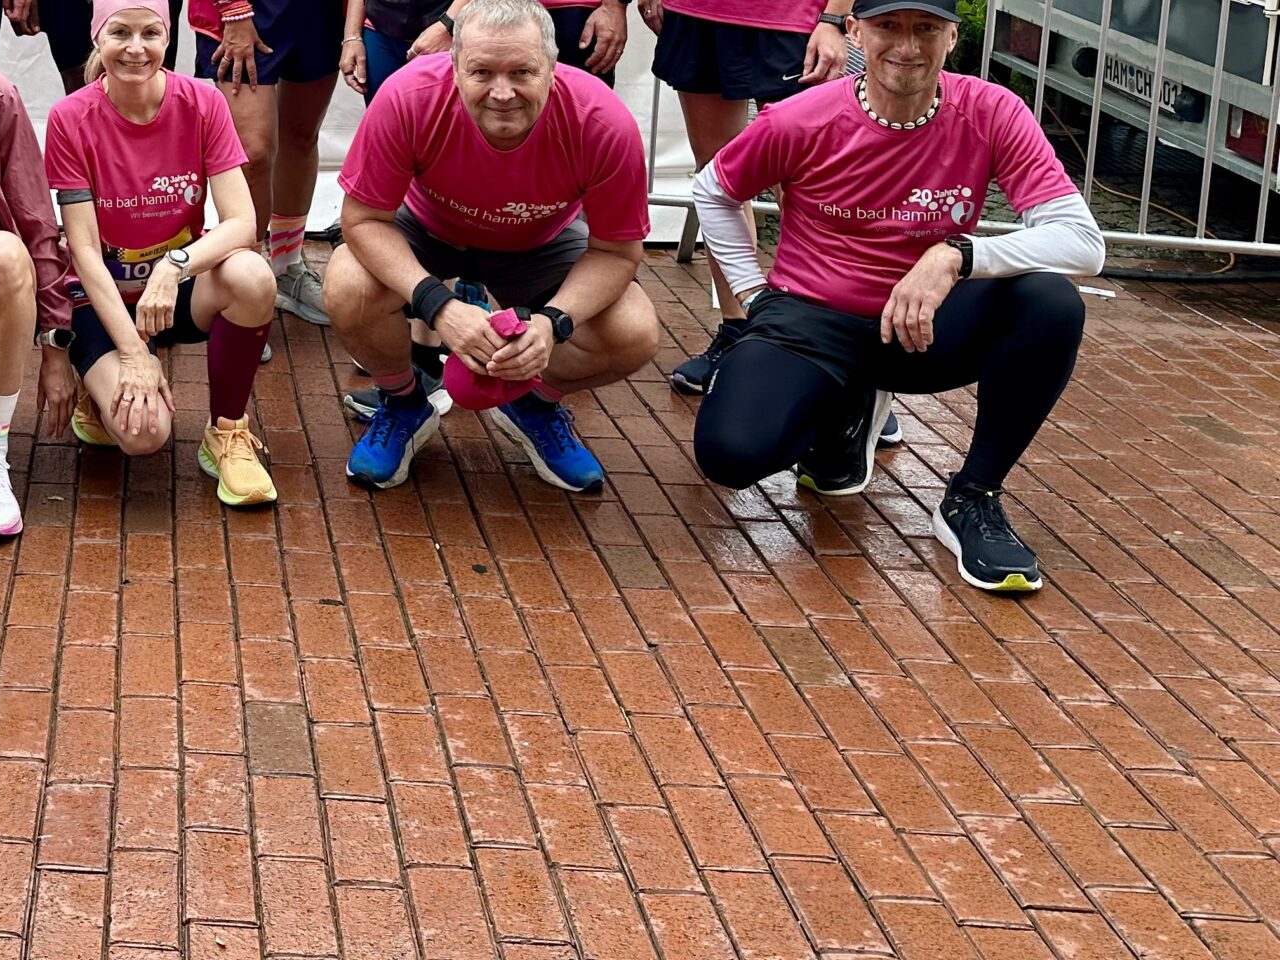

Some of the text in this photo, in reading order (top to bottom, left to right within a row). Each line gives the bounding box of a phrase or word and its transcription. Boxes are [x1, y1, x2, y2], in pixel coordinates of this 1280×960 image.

[1105, 55, 1128, 88] HAM
[1136, 69, 1152, 99] CH
[152, 174, 189, 190] 20 Jahre
[116, 194, 178, 208] bad hamm
[909, 189, 959, 204] 20 Jahre
[142, 210, 171, 219] bewegen
[449, 199, 478, 217] bad
[482, 210, 532, 225] hamm
[502, 202, 557, 215] 20 Jahre
[818, 203, 942, 221] reha bad hamm
